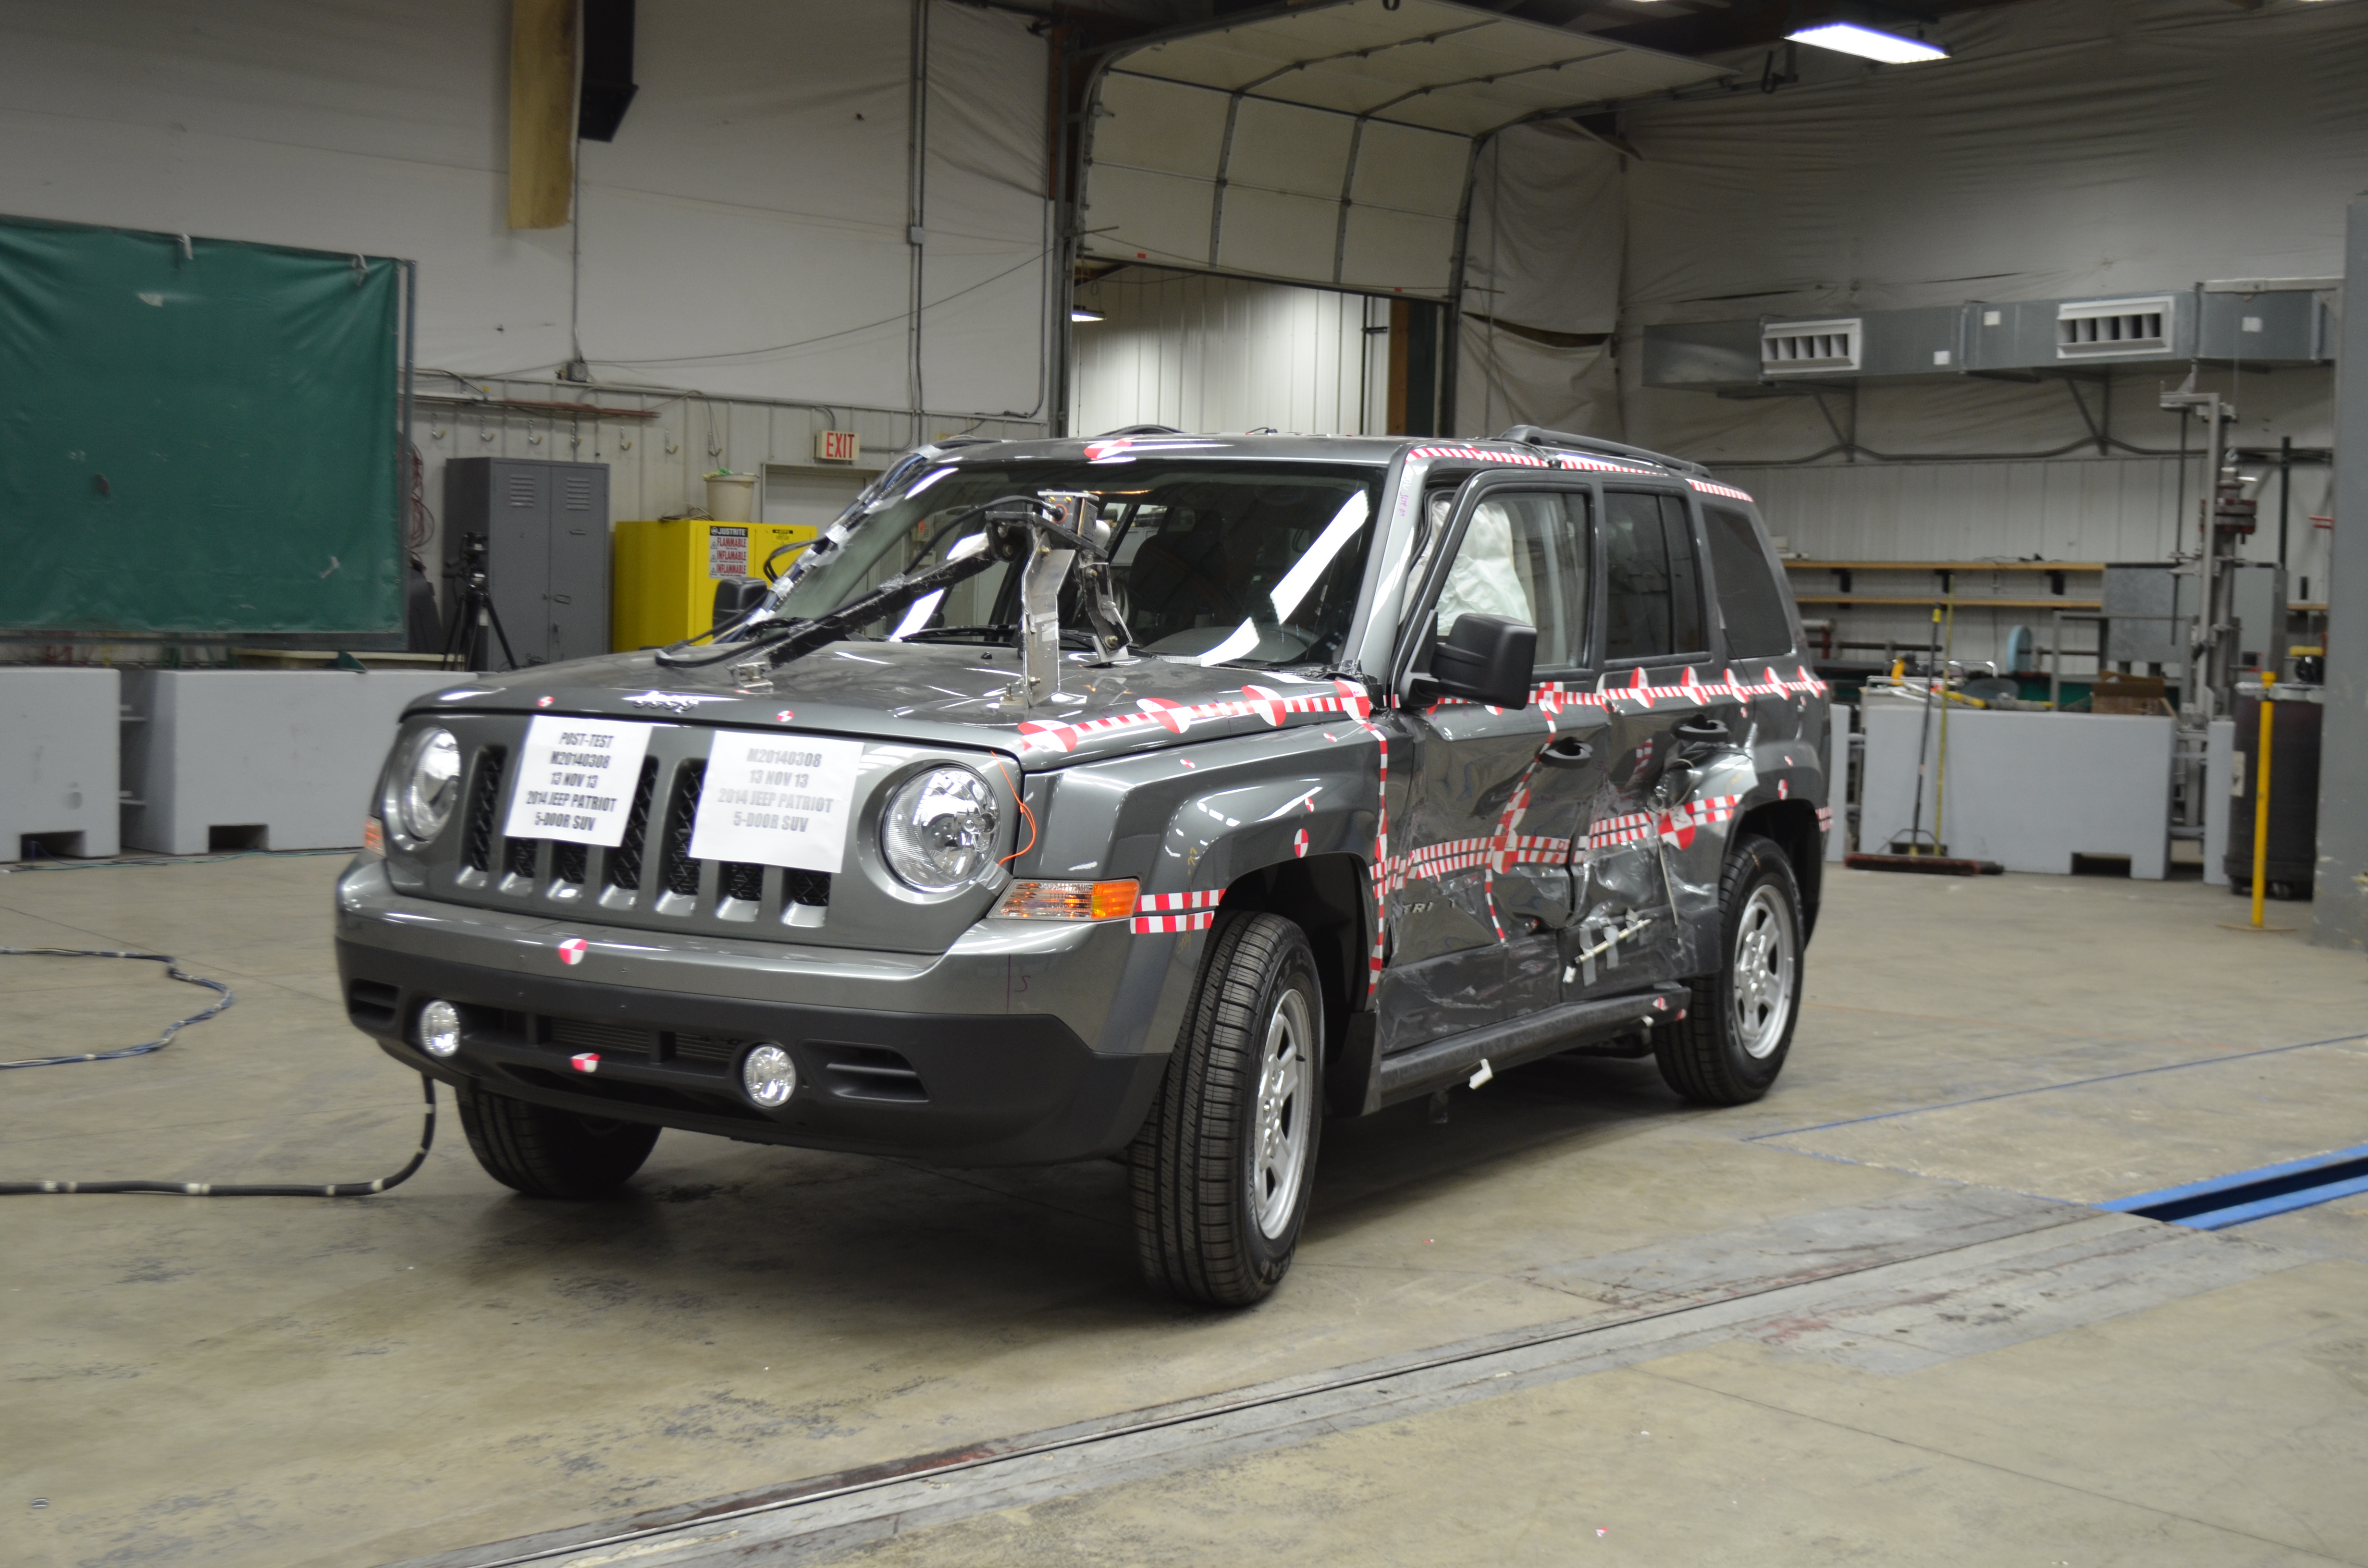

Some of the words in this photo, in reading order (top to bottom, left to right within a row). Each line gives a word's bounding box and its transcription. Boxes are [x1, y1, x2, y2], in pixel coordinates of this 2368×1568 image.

[826, 432, 854, 459] EXIT
[718, 527, 746, 536] JUSTRITE
[717, 537, 746, 548] FLAMMABLE
[716, 551, 746, 561] INFLAMABLE
[716, 564, 746, 575] INFLAMMABLE
[558, 732, 615, 748] POST-TEST
[549, 750, 611, 769] M20140308
[746, 748, 822, 768] M20140308
[551, 772, 562, 785] 13
[562, 772, 585, 787] NOV
[586, 775, 599, 789] 13
[749, 769, 764, 784] 13
[765, 770, 793, 786] NOV
[794, 773, 809, 788] 13
[526, 790, 548, 805] 2014
[548, 792, 570, 807] JEEP
[570, 794, 617, 812] PATRIOT
[717, 788, 748, 805] 2014
[750, 790, 777, 807] JEEP
[777, 793, 834, 813] PATRIOT
[534, 811, 571, 828] 5-DOOR
[572, 815, 596, 831] SUV
[733, 811, 779, 829] 5-DOOR
[781, 815, 809, 832] SUV
